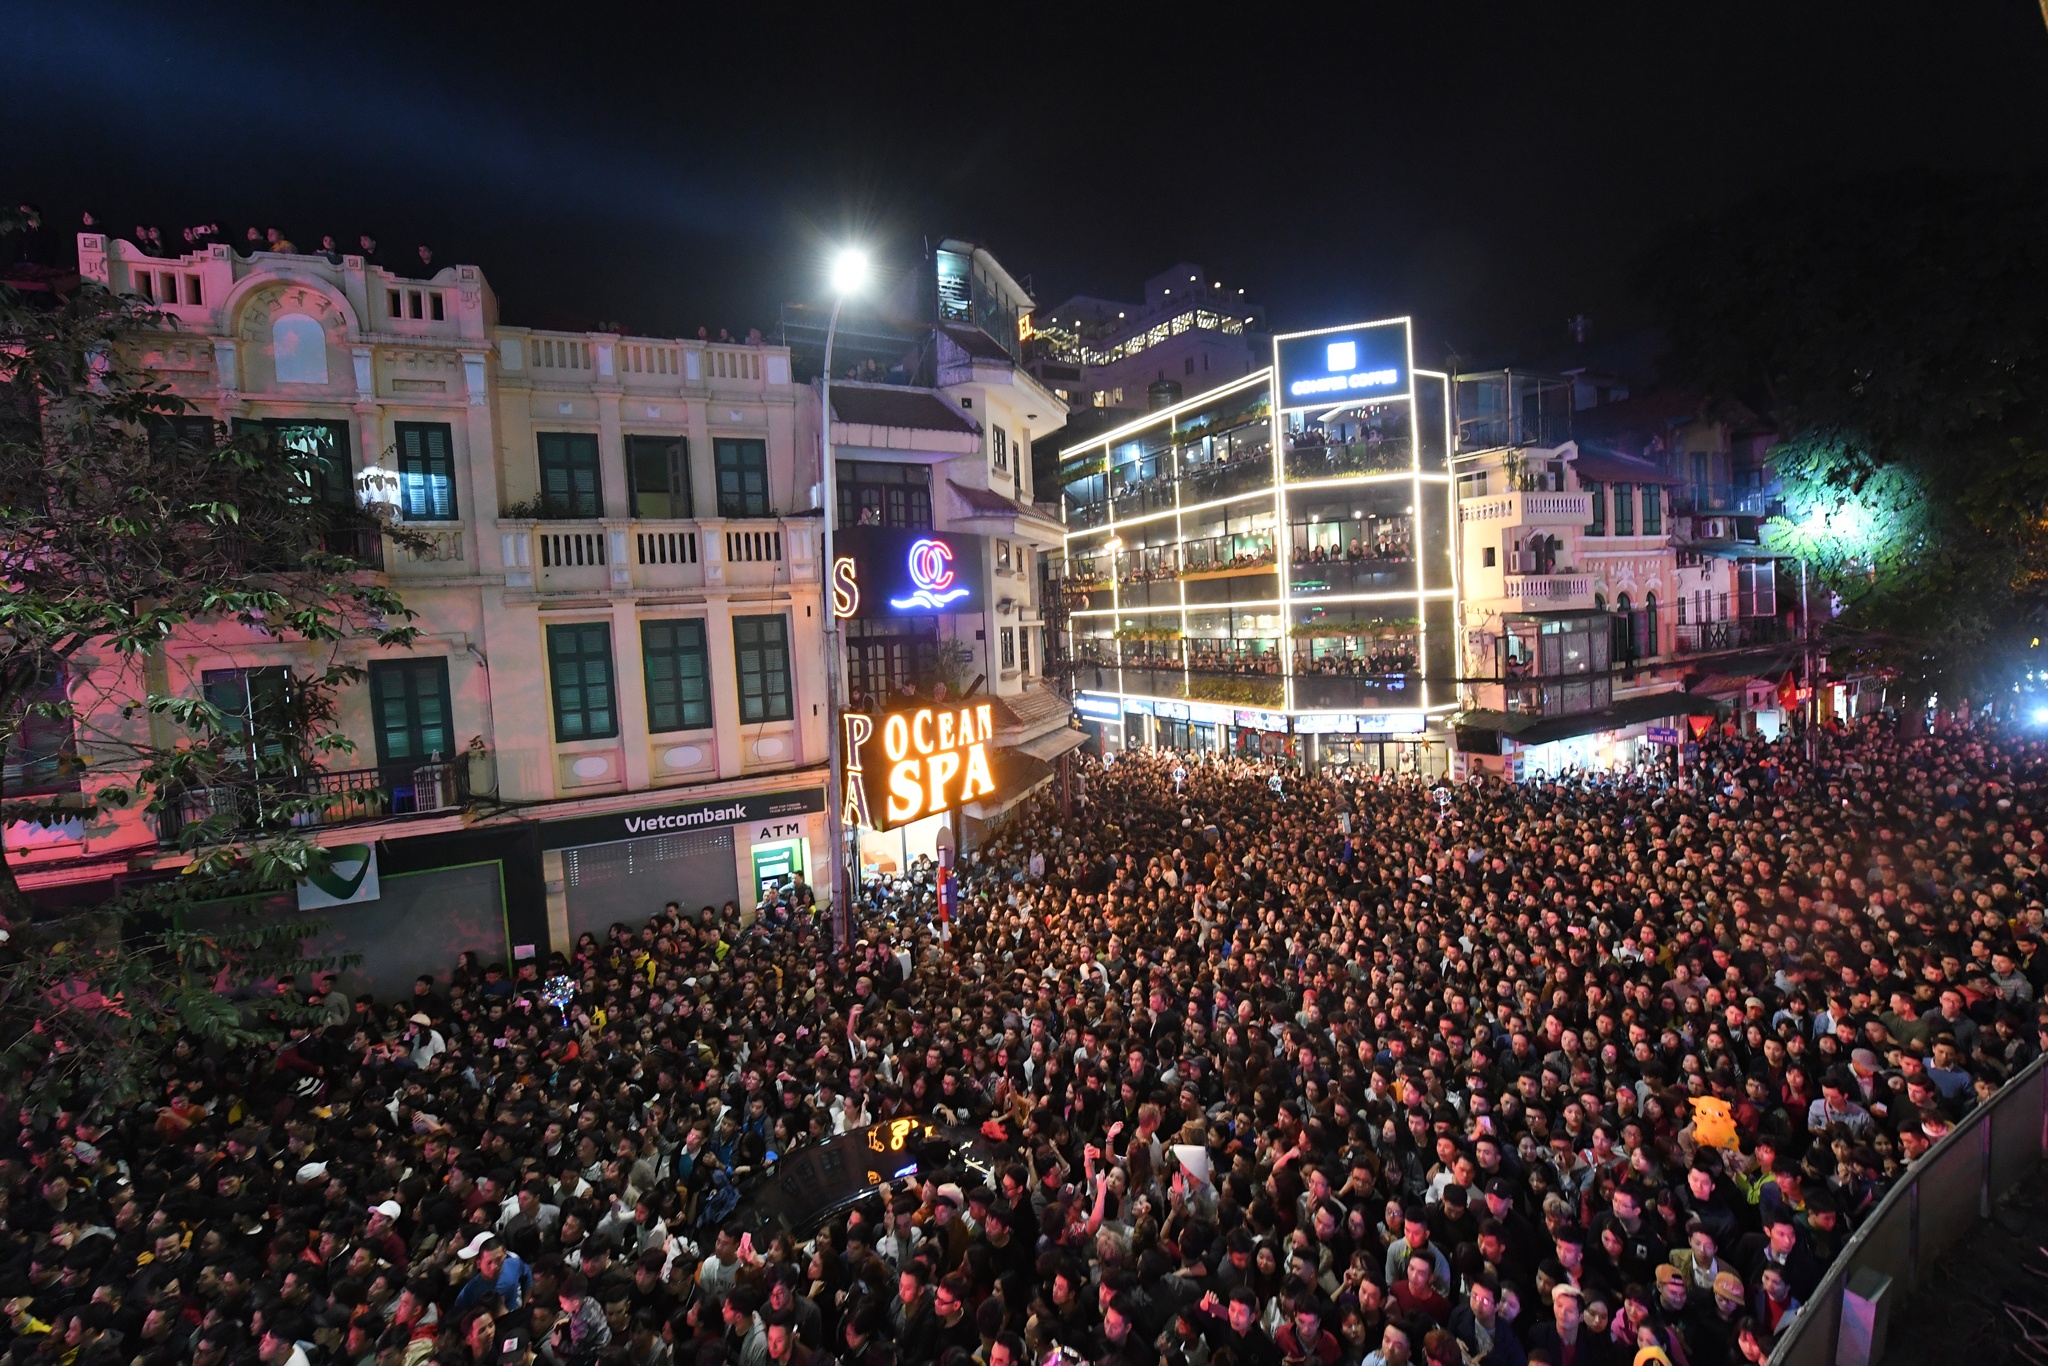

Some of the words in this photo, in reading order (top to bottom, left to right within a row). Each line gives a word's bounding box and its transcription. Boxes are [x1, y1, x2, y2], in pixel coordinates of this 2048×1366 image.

[885, 705, 992, 762] OCEAN
[888, 743, 995, 822] SPA
[625, 803, 746, 833] Vietcombank
[759, 823, 799, 840] ATM
